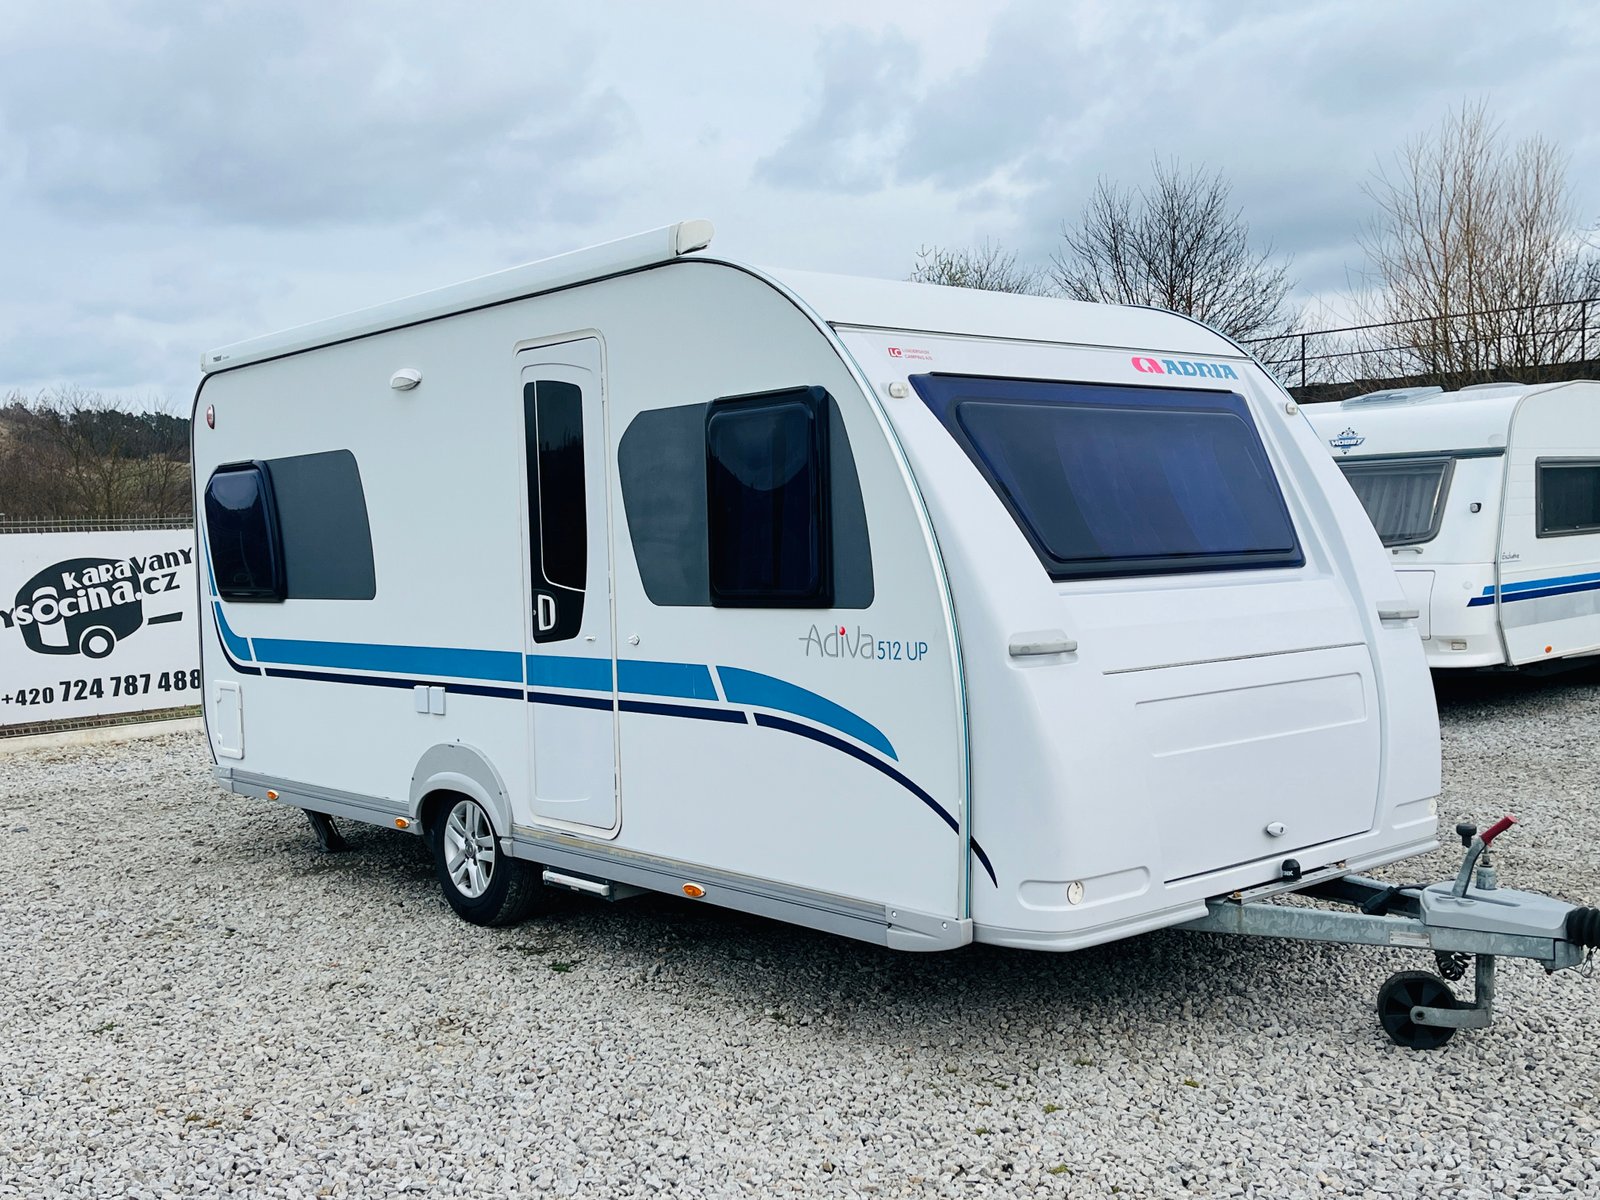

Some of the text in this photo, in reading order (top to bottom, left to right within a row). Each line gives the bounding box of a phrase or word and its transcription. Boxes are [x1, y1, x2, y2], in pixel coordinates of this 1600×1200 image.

[1161, 359, 1239, 380] ADRIA
[1330, 438, 1364, 446] HOBBY
[877, 640, 902, 661] 512
[906, 641, 928, 661] UP
[1, 668, 201, 706] +420 724 787 488
